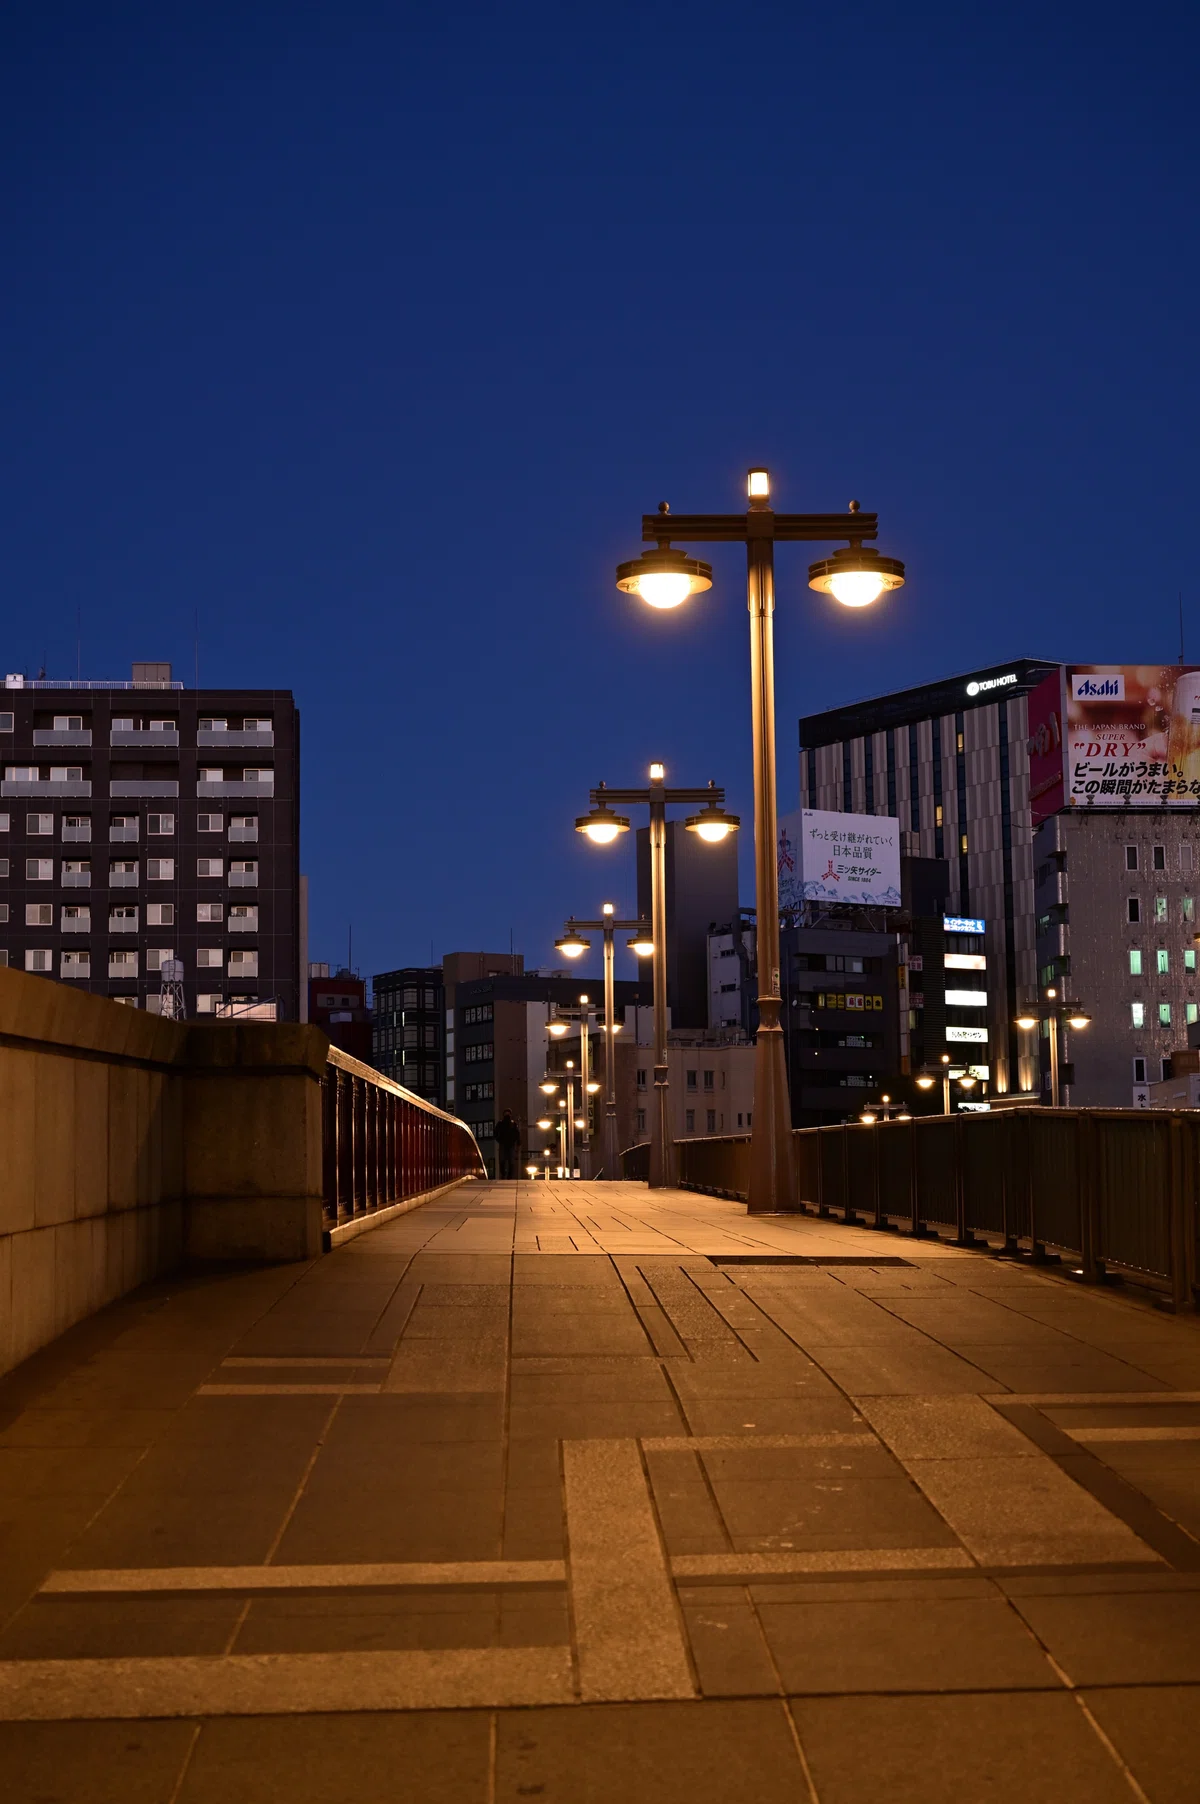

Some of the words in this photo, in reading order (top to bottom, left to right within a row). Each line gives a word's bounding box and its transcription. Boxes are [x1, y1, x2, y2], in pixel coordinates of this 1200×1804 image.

[979, 679, 997, 691] TOBU
[997, 674, 1018, 686] HOTEL
[1077, 679, 1119, 696] Asahi
[1091, 723, 1118, 731] JAPAN
[1096, 733, 1126, 741] SUPER
[1074, 761, 1185, 778] ビールがうまい。
[809, 828, 893, 846] ずっと受け継がれていく
[833, 845, 873, 860] 日本品質
